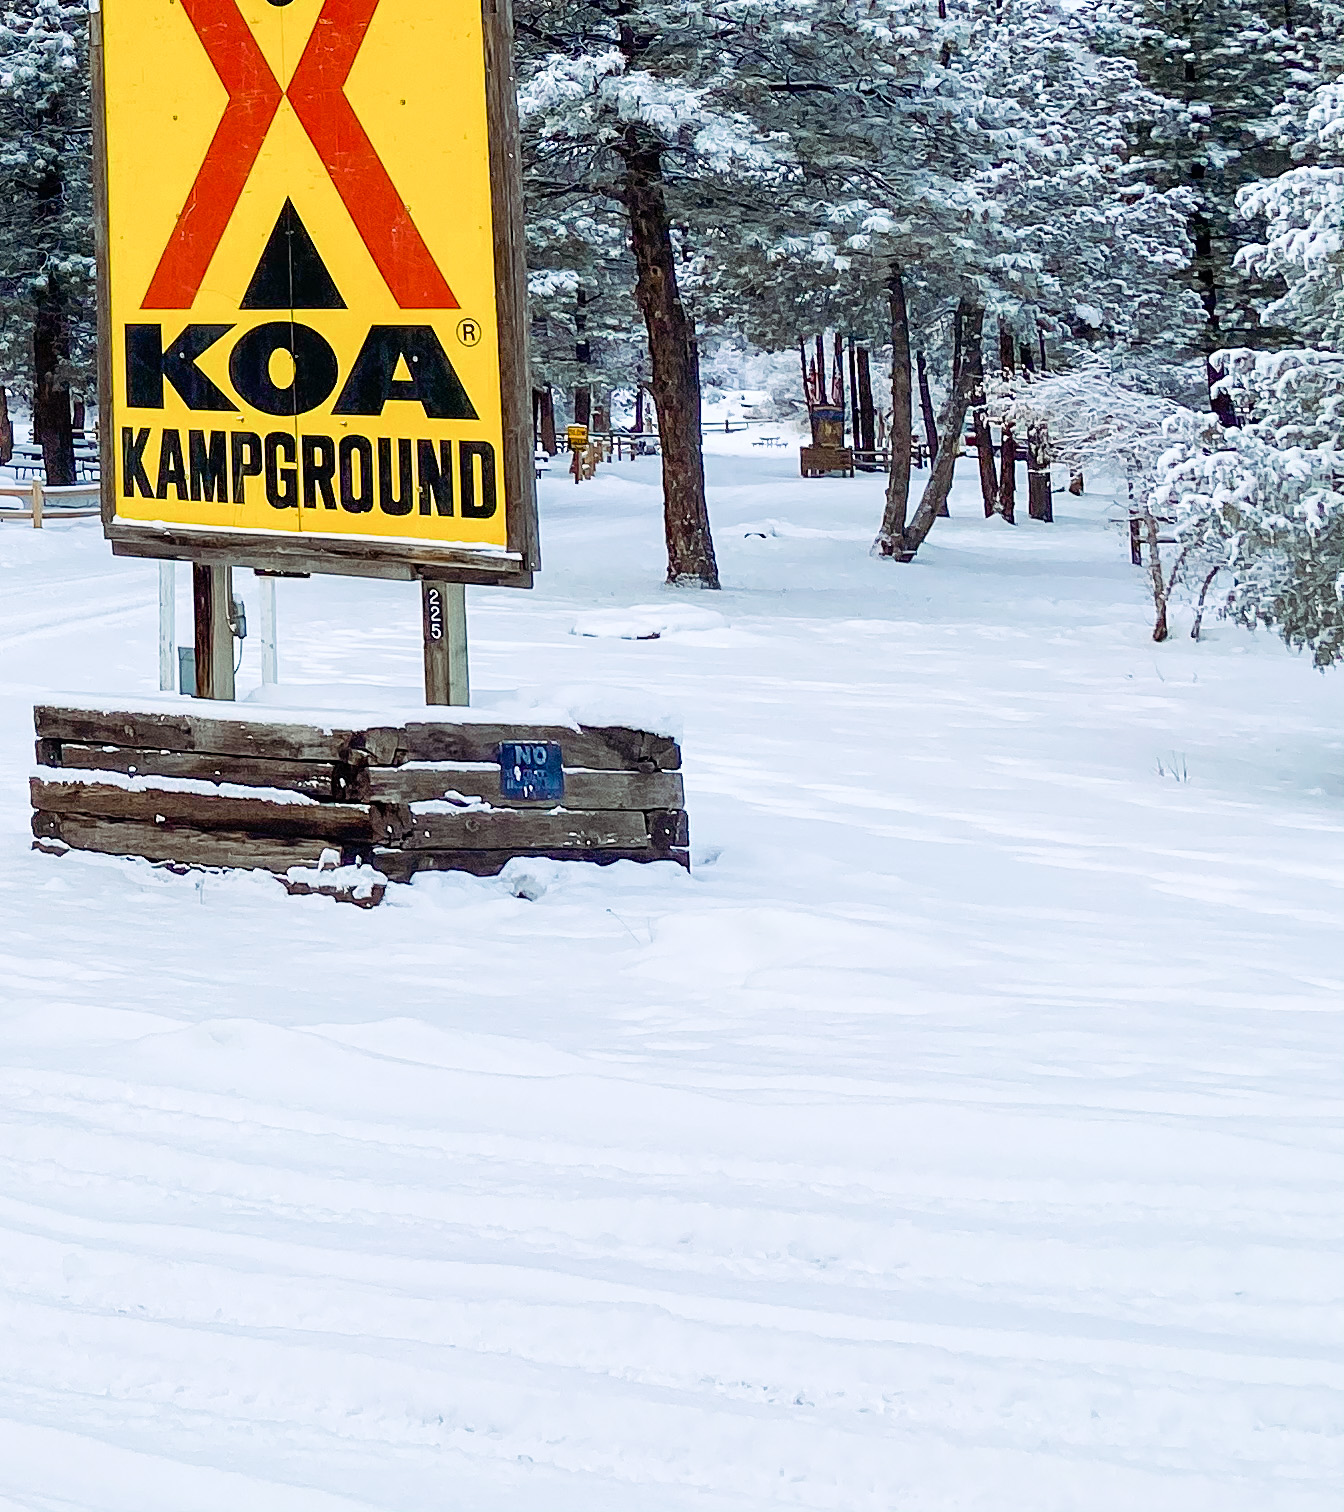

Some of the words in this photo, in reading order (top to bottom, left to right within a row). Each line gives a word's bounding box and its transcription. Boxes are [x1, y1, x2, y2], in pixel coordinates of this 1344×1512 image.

[124, 321, 480, 420] KOA
[122, 426, 497, 519] KAMPGROUND
[429, 589, 442, 640] 225
[514, 745, 547, 765] NO
